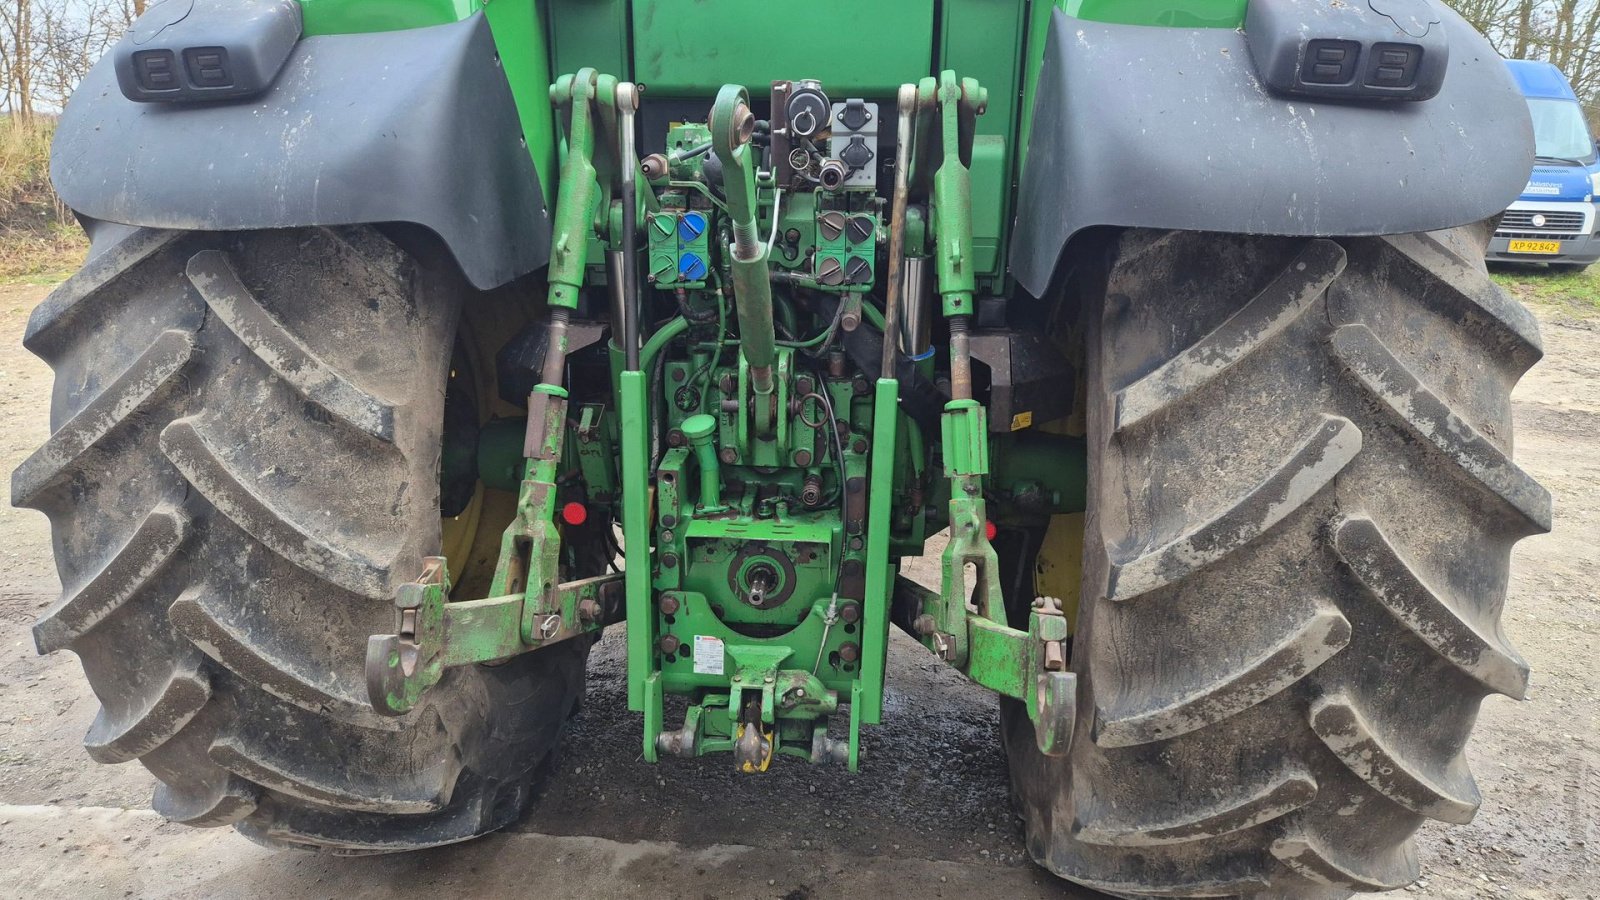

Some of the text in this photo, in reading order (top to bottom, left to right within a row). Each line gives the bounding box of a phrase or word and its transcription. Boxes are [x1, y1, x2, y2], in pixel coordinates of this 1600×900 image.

[1512, 242, 1556, 252] XP 92 842
